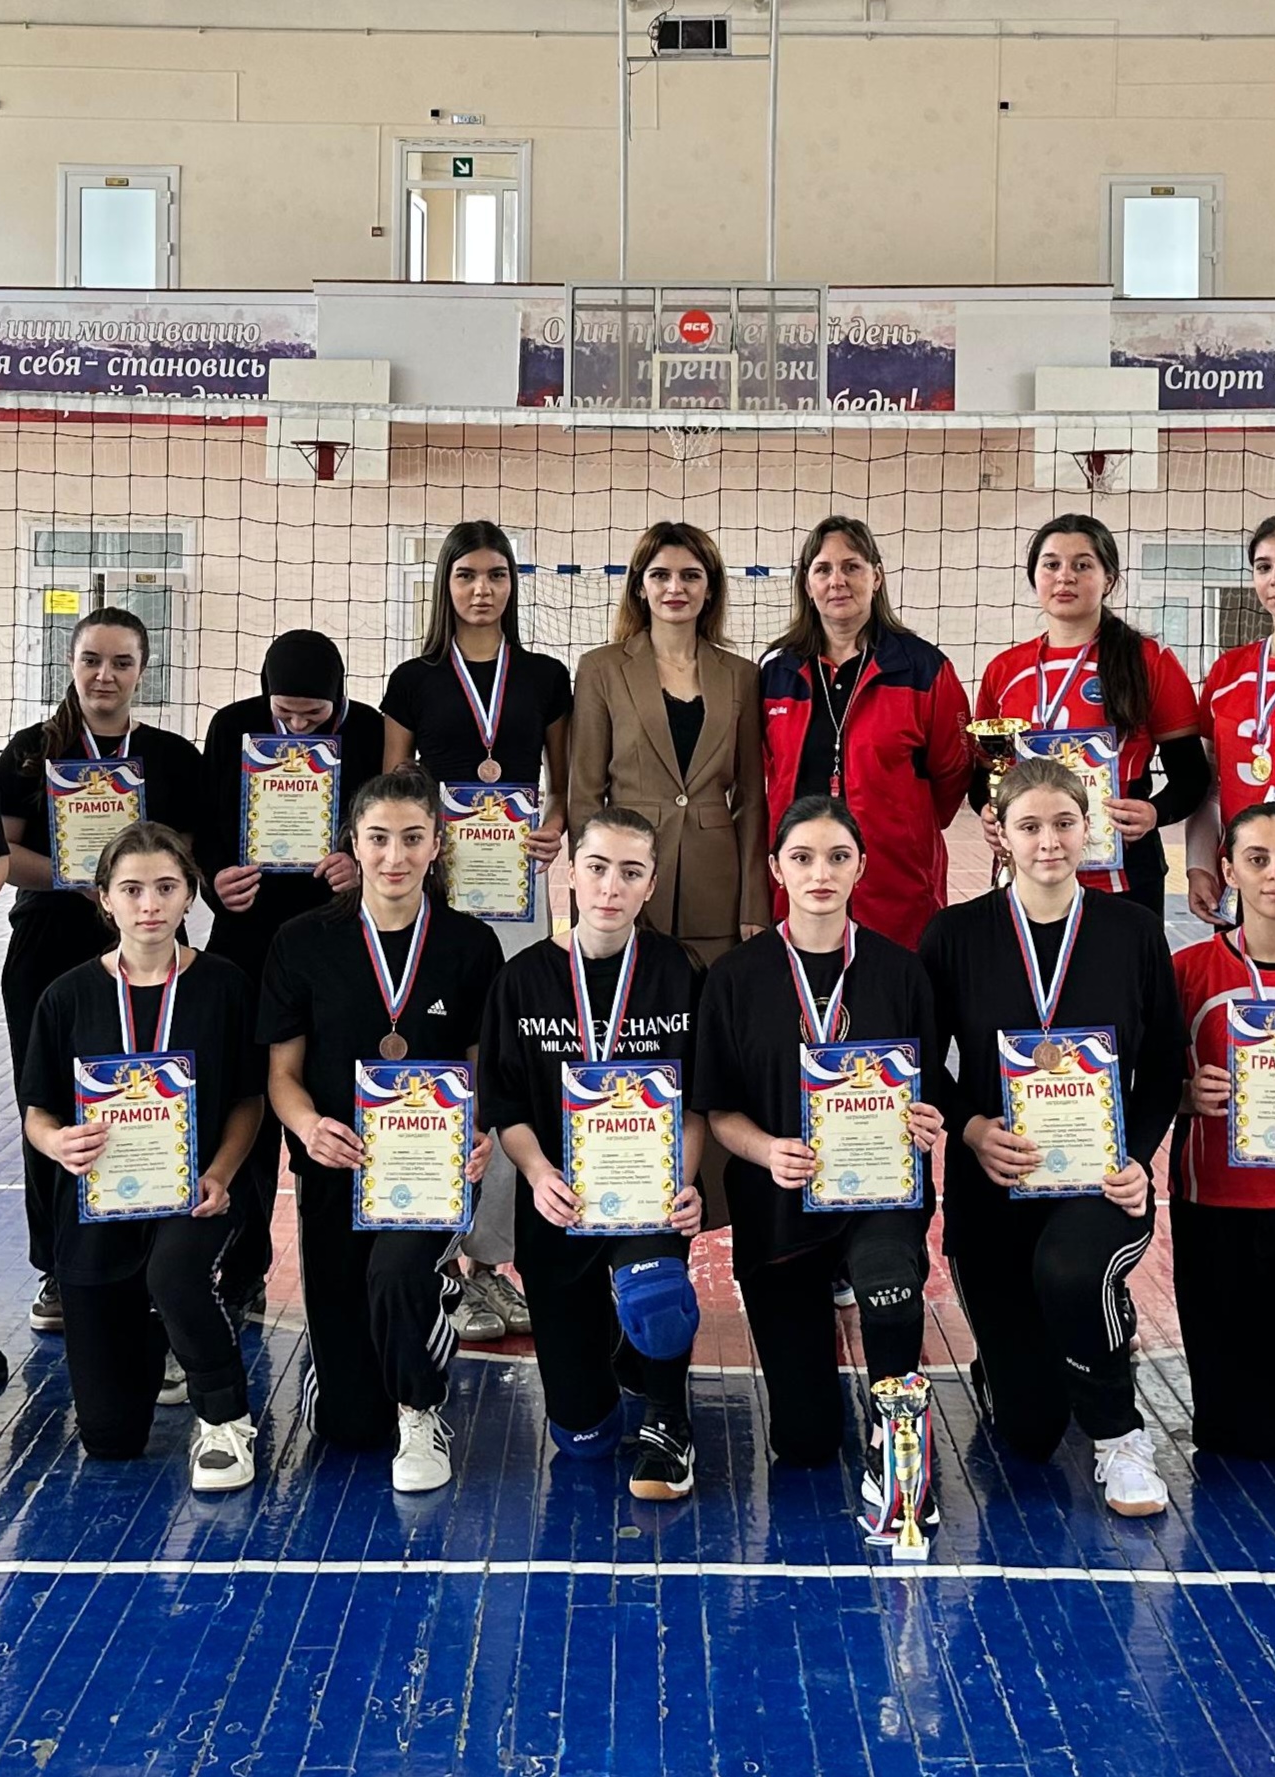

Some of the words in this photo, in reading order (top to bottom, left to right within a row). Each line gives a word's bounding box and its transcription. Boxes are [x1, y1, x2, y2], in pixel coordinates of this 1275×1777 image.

[6, 321, 72, 349] ищи
[74, 320, 262, 351] мотивацию
[849, 315, 918, 346] день
[107, 354, 266, 378] становись
[1164, 364, 1265, 398] Спорт
[1236, 718, 1272, 786] 3
[263, 779, 319, 792] ГРАМОТА
[68, 800, 125, 813] ГРАМОТА
[459, 828, 516, 841] ГРАМОТА
[517, 1017, 582, 1037] RMAN
[541, 1040, 584, 1053] MILAN
[628, 1040, 661, 1053] YORK
[1026, 1082, 1095, 1099] ГРАМОТА
[826, 1095, 895, 1113] ГРАМОТА
[101, 1106, 170, 1124] ГРАМОТА
[380, 1115, 447, 1131] ГРАМОТА
[588, 1117, 656, 1134] ГРАМОТА
[868, 1287, 912, 1308] VELO
